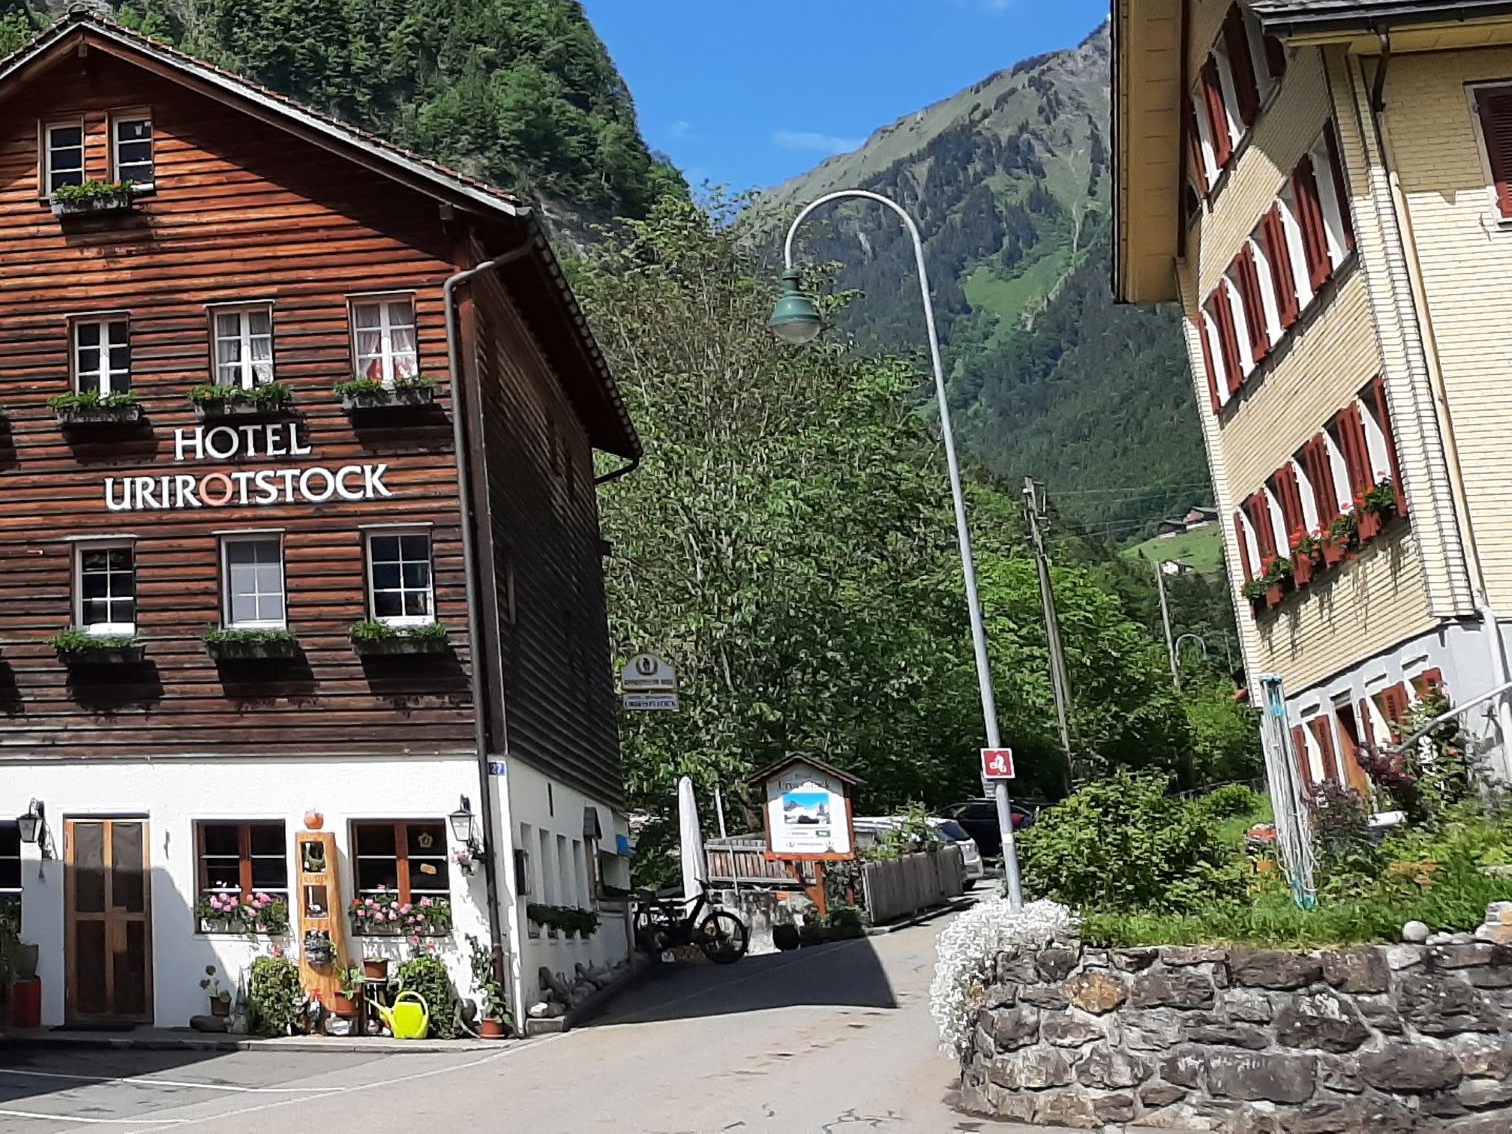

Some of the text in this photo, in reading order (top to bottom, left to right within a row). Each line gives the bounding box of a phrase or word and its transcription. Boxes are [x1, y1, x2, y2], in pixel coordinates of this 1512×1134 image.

[174, 422, 311, 461] HOTEL
[104, 464, 393, 511] URIROTSTOCK
[491, 763, 502, 774] 27
